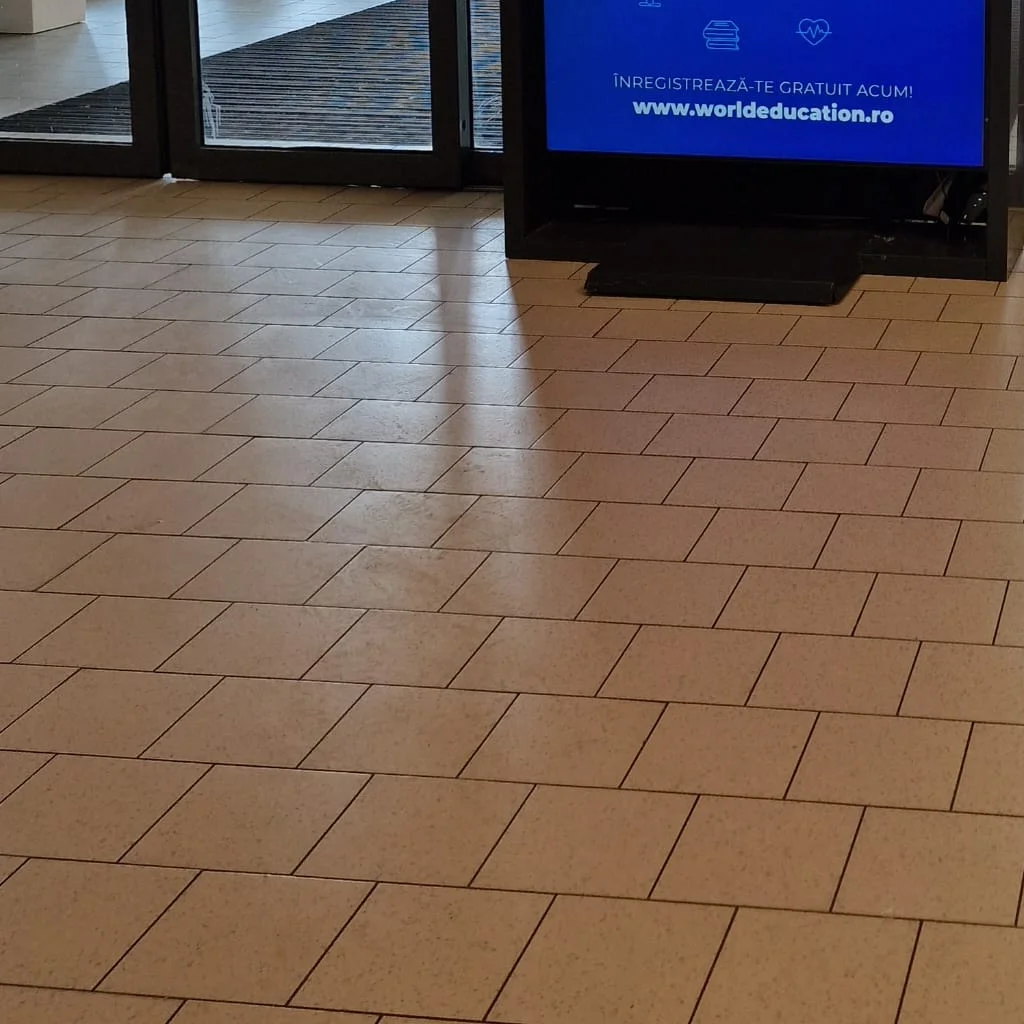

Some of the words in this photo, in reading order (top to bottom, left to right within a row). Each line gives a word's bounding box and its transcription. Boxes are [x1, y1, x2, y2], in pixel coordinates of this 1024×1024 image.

[612, 72, 774, 94] ÎNREGISTREAZĂ-TE
[779, 80, 853, 96] GRATUIT
[856, 83, 914, 99] ACUM!
[632, 98, 898, 124] www.worldeducation.ro
